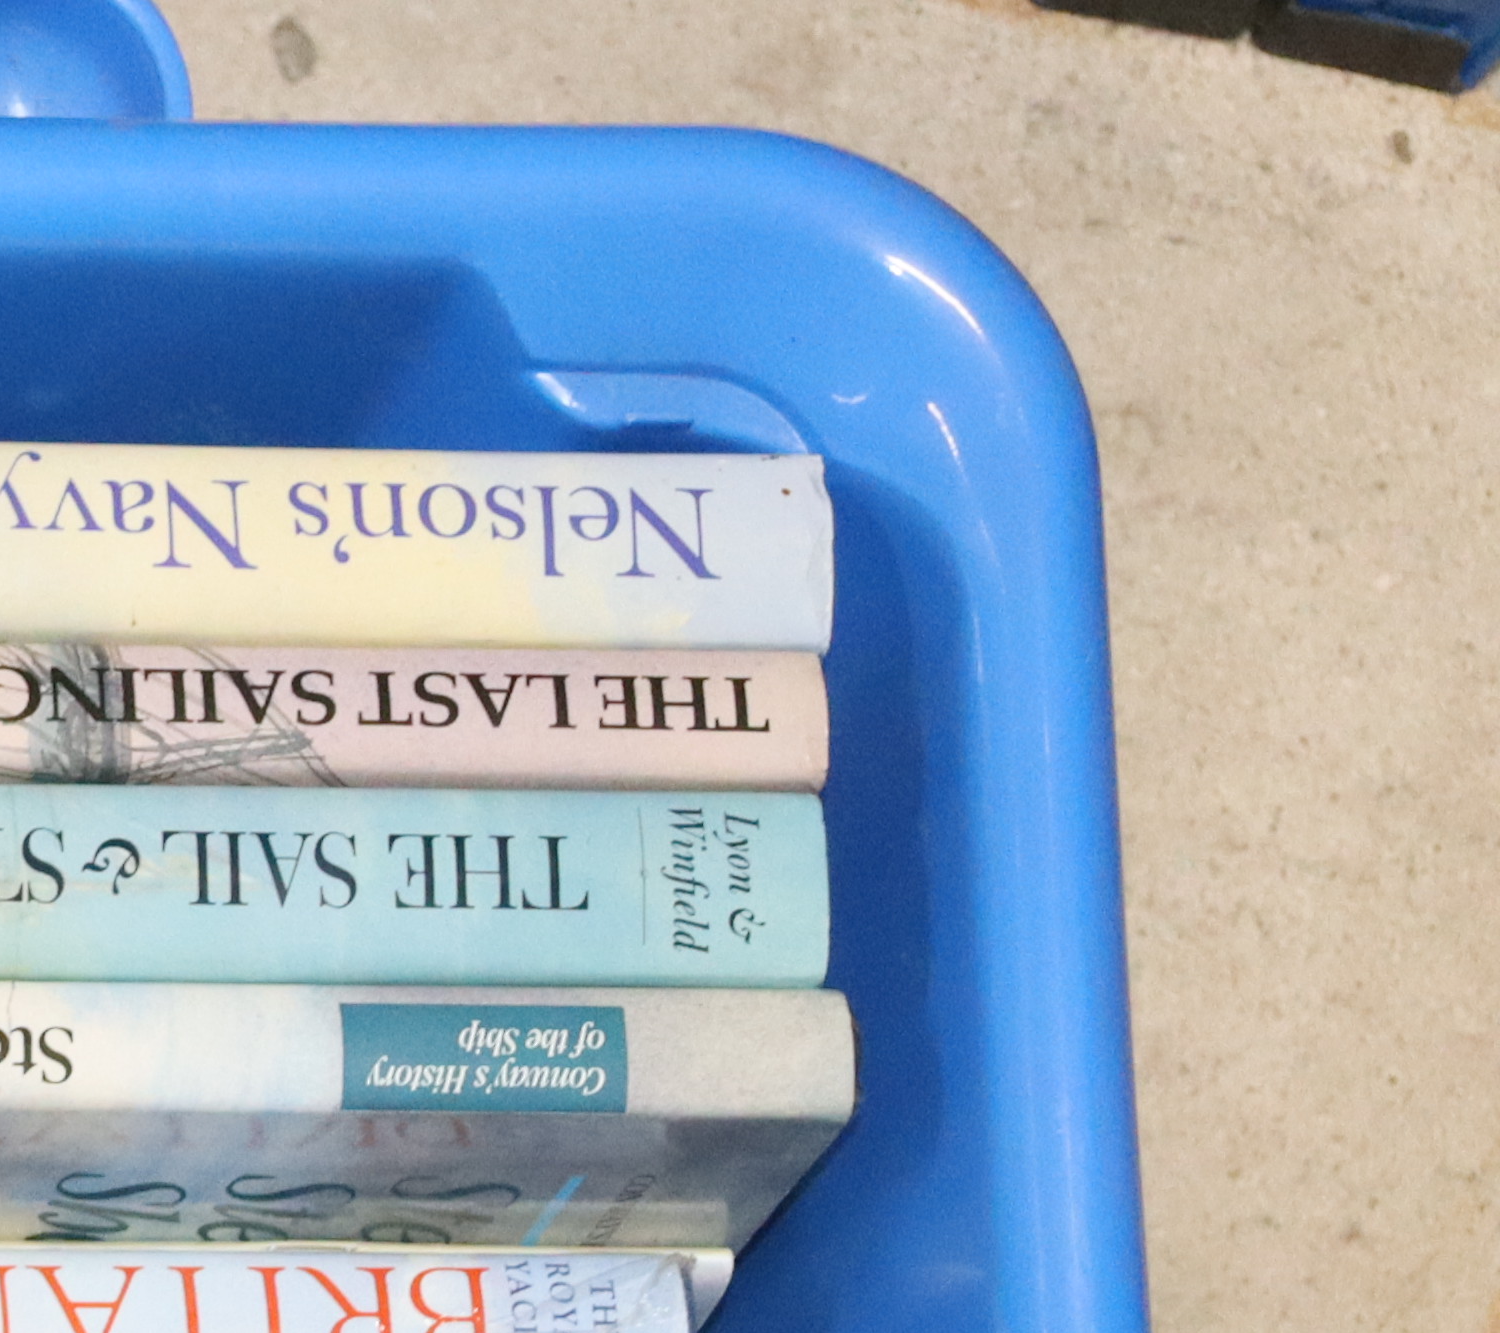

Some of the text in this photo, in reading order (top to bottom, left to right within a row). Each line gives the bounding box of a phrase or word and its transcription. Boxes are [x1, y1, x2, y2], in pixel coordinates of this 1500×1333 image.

[289, 483, 718, 579] Nelson's
[359, 672, 574, 728] LAST
[594, 676, 769, 732] THE
[83, 838, 140, 894] &
[163, 831, 356, 905] SAIL
[389, 835, 588, 910] THE
[664, 809, 709, 952] Winfield
[725, 814, 759, 943] Lyon &
[459, 1021, 605, 1057] of the Ship
[367, 1056, 605, 1095] Conway's History
